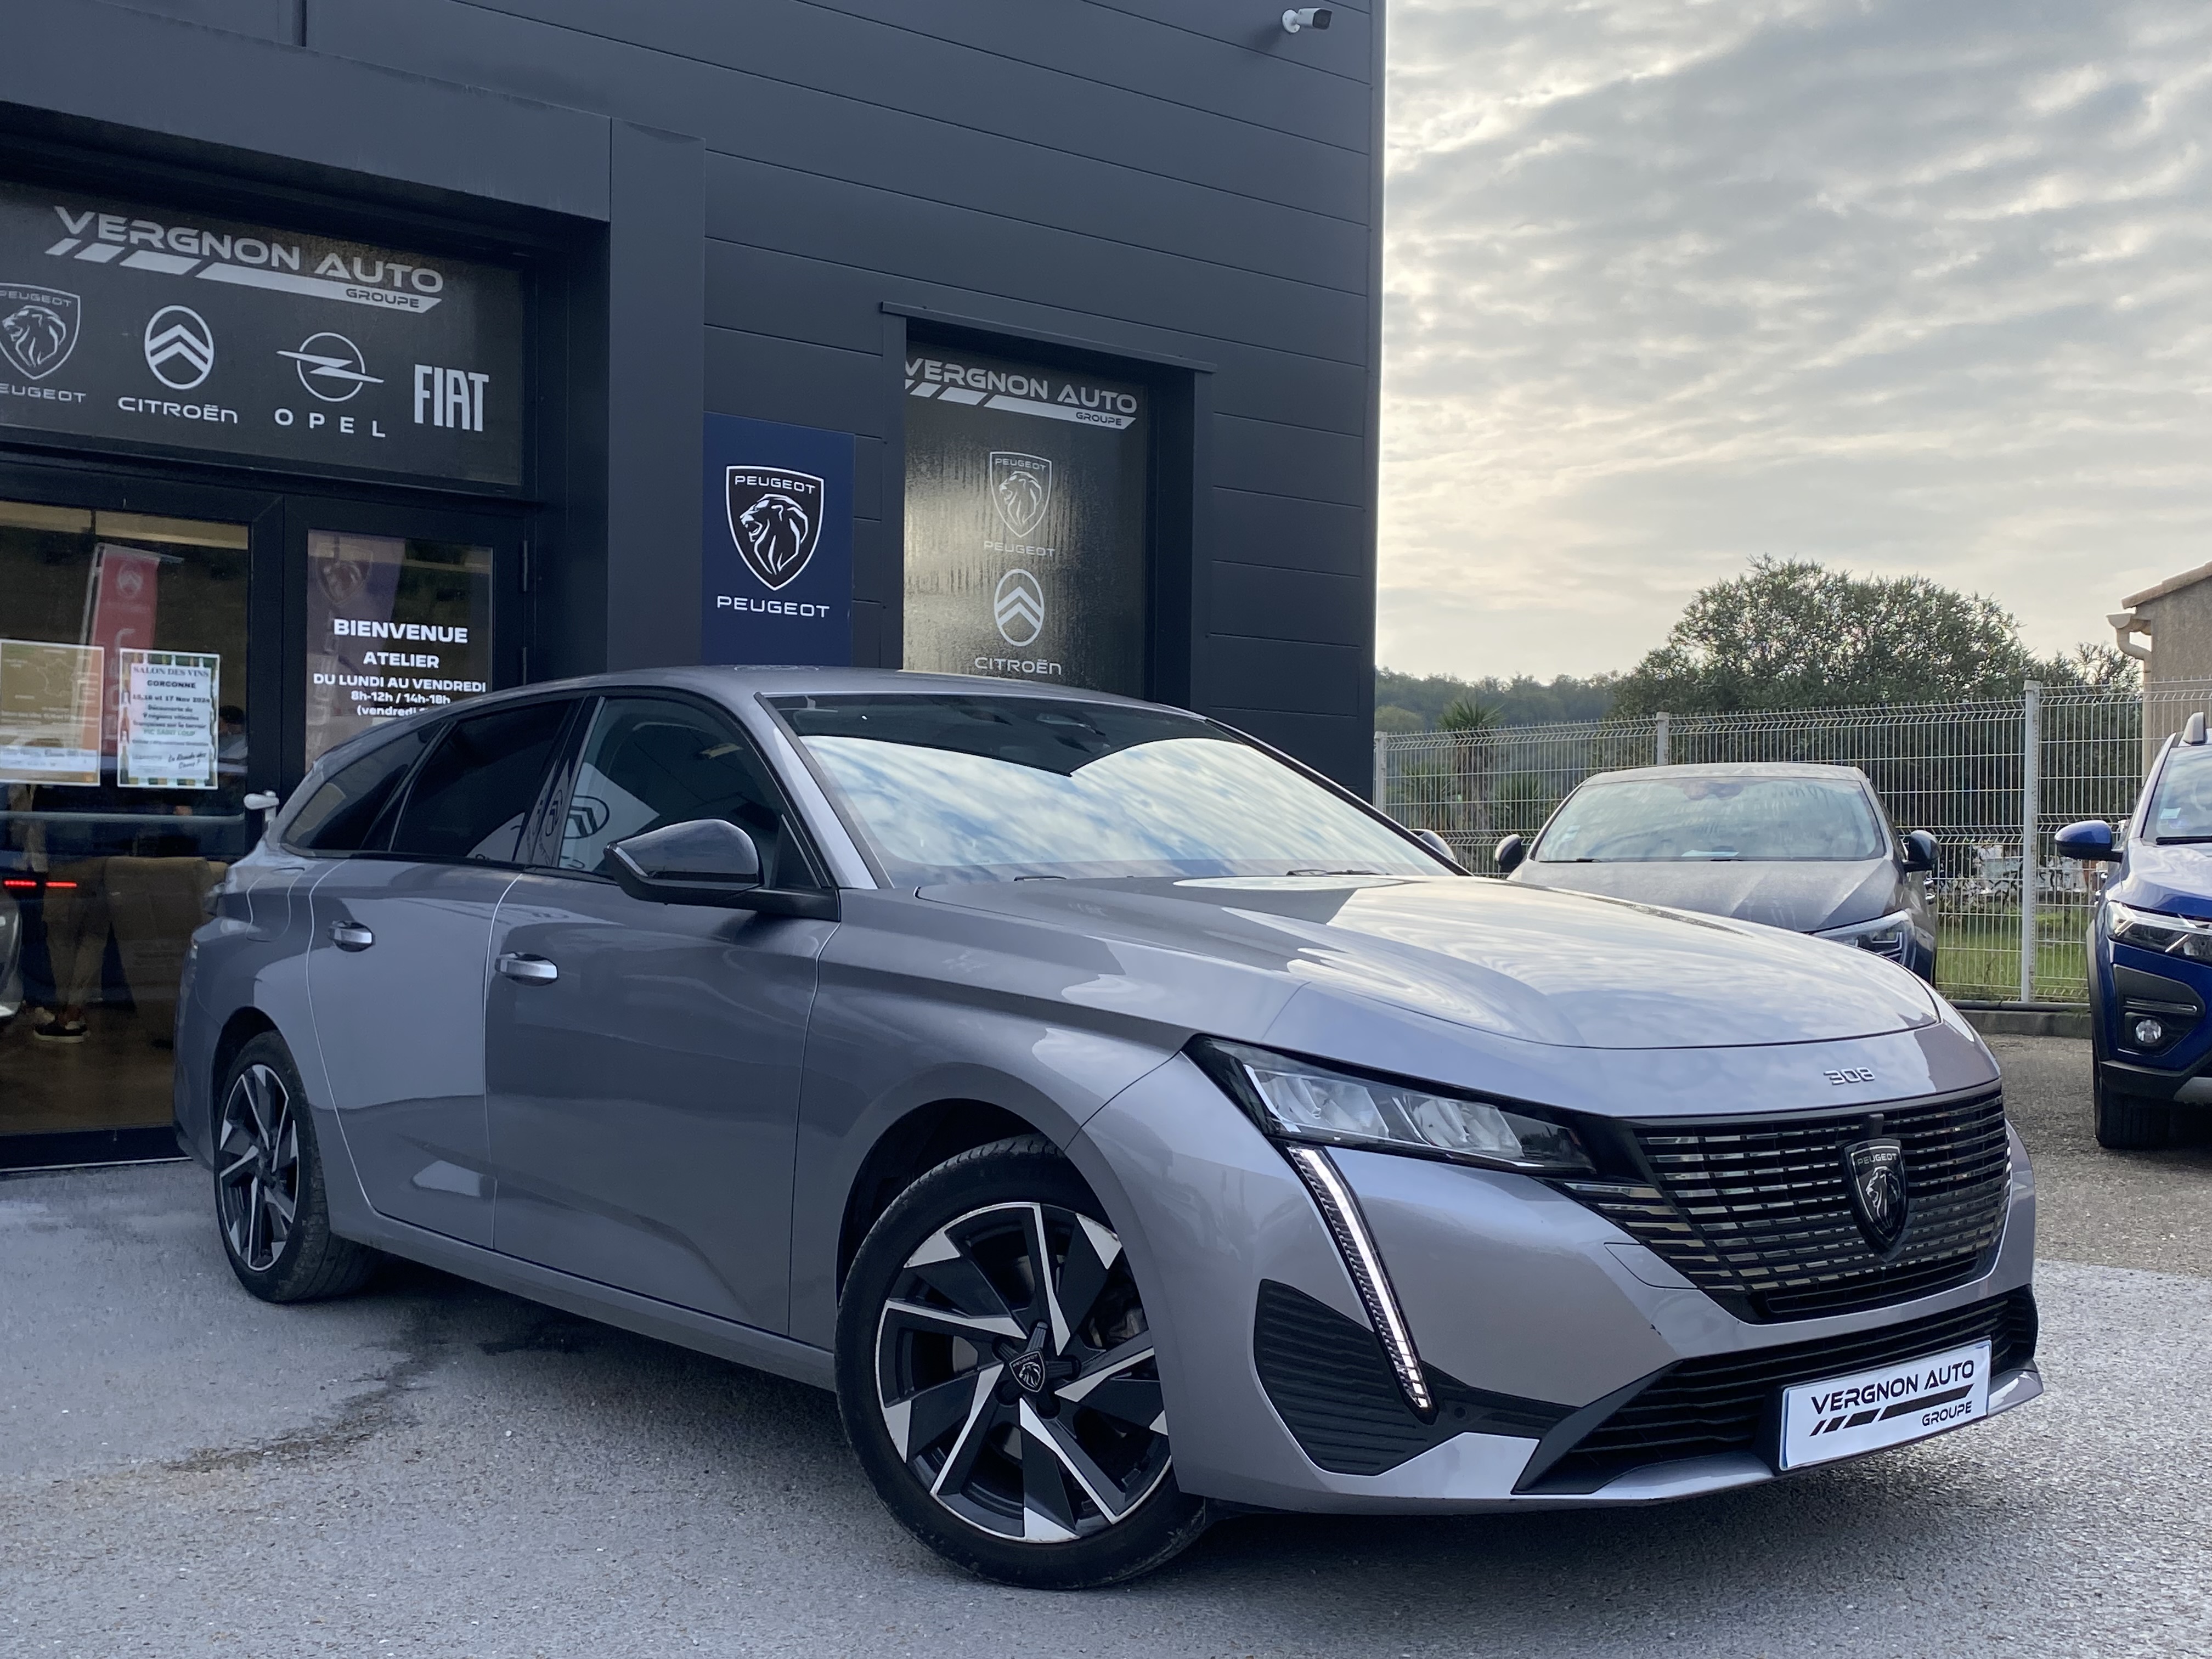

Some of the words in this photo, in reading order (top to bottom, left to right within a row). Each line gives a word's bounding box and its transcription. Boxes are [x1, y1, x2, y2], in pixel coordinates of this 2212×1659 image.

[55, 206, 300, 270] VERGNON
[314, 252, 443, 293] AUTO
[346, 288, 419, 308] GROUPE
[0, 383, 86, 403] EUGEOT
[906, 358, 1048, 399] VERGNON
[1057, 384, 1137, 413] AUTO
[415, 364, 489, 431] FIAT
[274, 408, 386, 437] OPEL
[1076, 412, 1122, 426] GROUPE
[995, 458, 1046, 471] PEUGEOT
[735, 476, 815, 494] PEUGEOT
[984, 541, 1055, 557] PEUGEOT
[717, 596, 830, 617] PEUGEOT
[334, 618, 468, 644] BIENVENUE
[363, 651, 439, 668] ATELIER
[133, 667, 165, 675] SALON
[313, 673, 335, 685] DU
[339, 674, 383, 687] LUNDI
[387, 677, 409, 689] AU
[412, 678, 486, 692] VENDREDI
[351, 690, 393, 702] 8h-12h
[396, 692, 402, 704] /
[404, 693, 451, 704] 14h-18h
[1823, 1066, 1875, 1085] 308
[1857, 1153, 1897, 1166] PEUGEOT
[1811, 1373, 1918, 1414] VERGNON
[1923, 1360, 1974, 1390] AUTO
[1922, 1401, 1973, 1426] GROUPE
